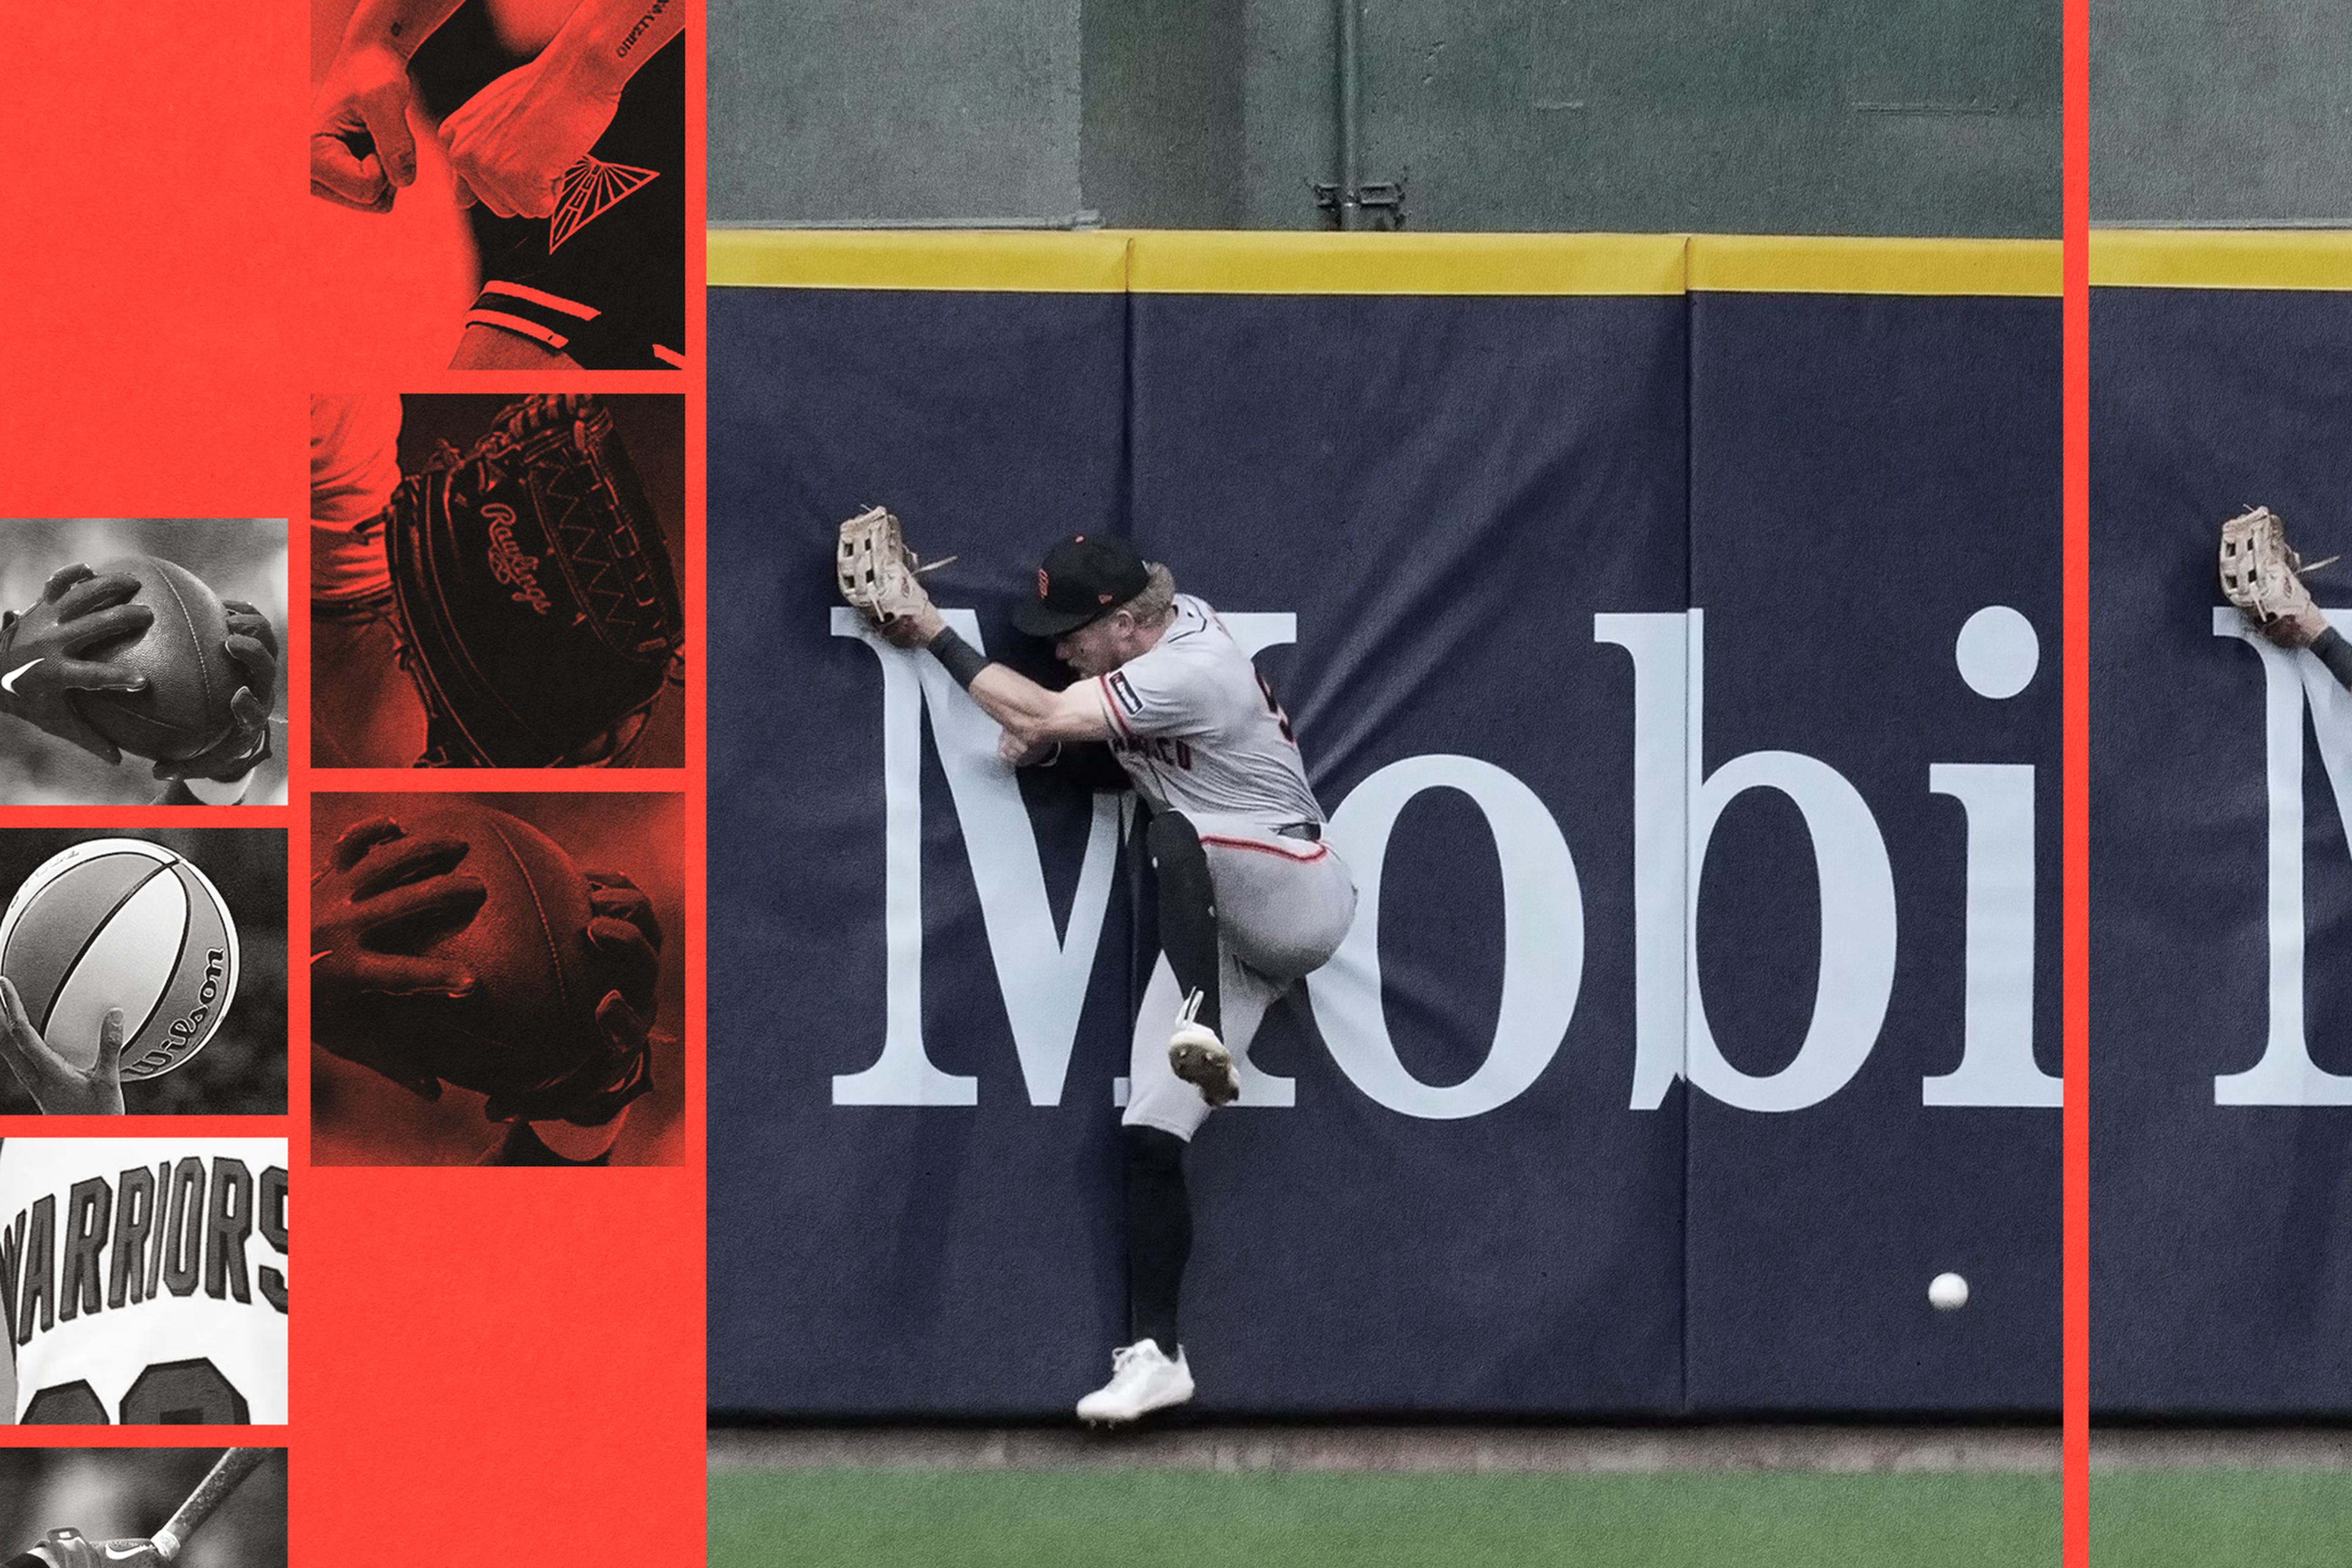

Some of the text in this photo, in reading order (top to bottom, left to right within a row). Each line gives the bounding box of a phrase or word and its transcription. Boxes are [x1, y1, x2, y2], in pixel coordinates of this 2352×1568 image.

[480, 503, 551, 615] Rawlings
[831, 605, 2064, 1120] Mobi
[119, 948, 225, 1076] Wilson
